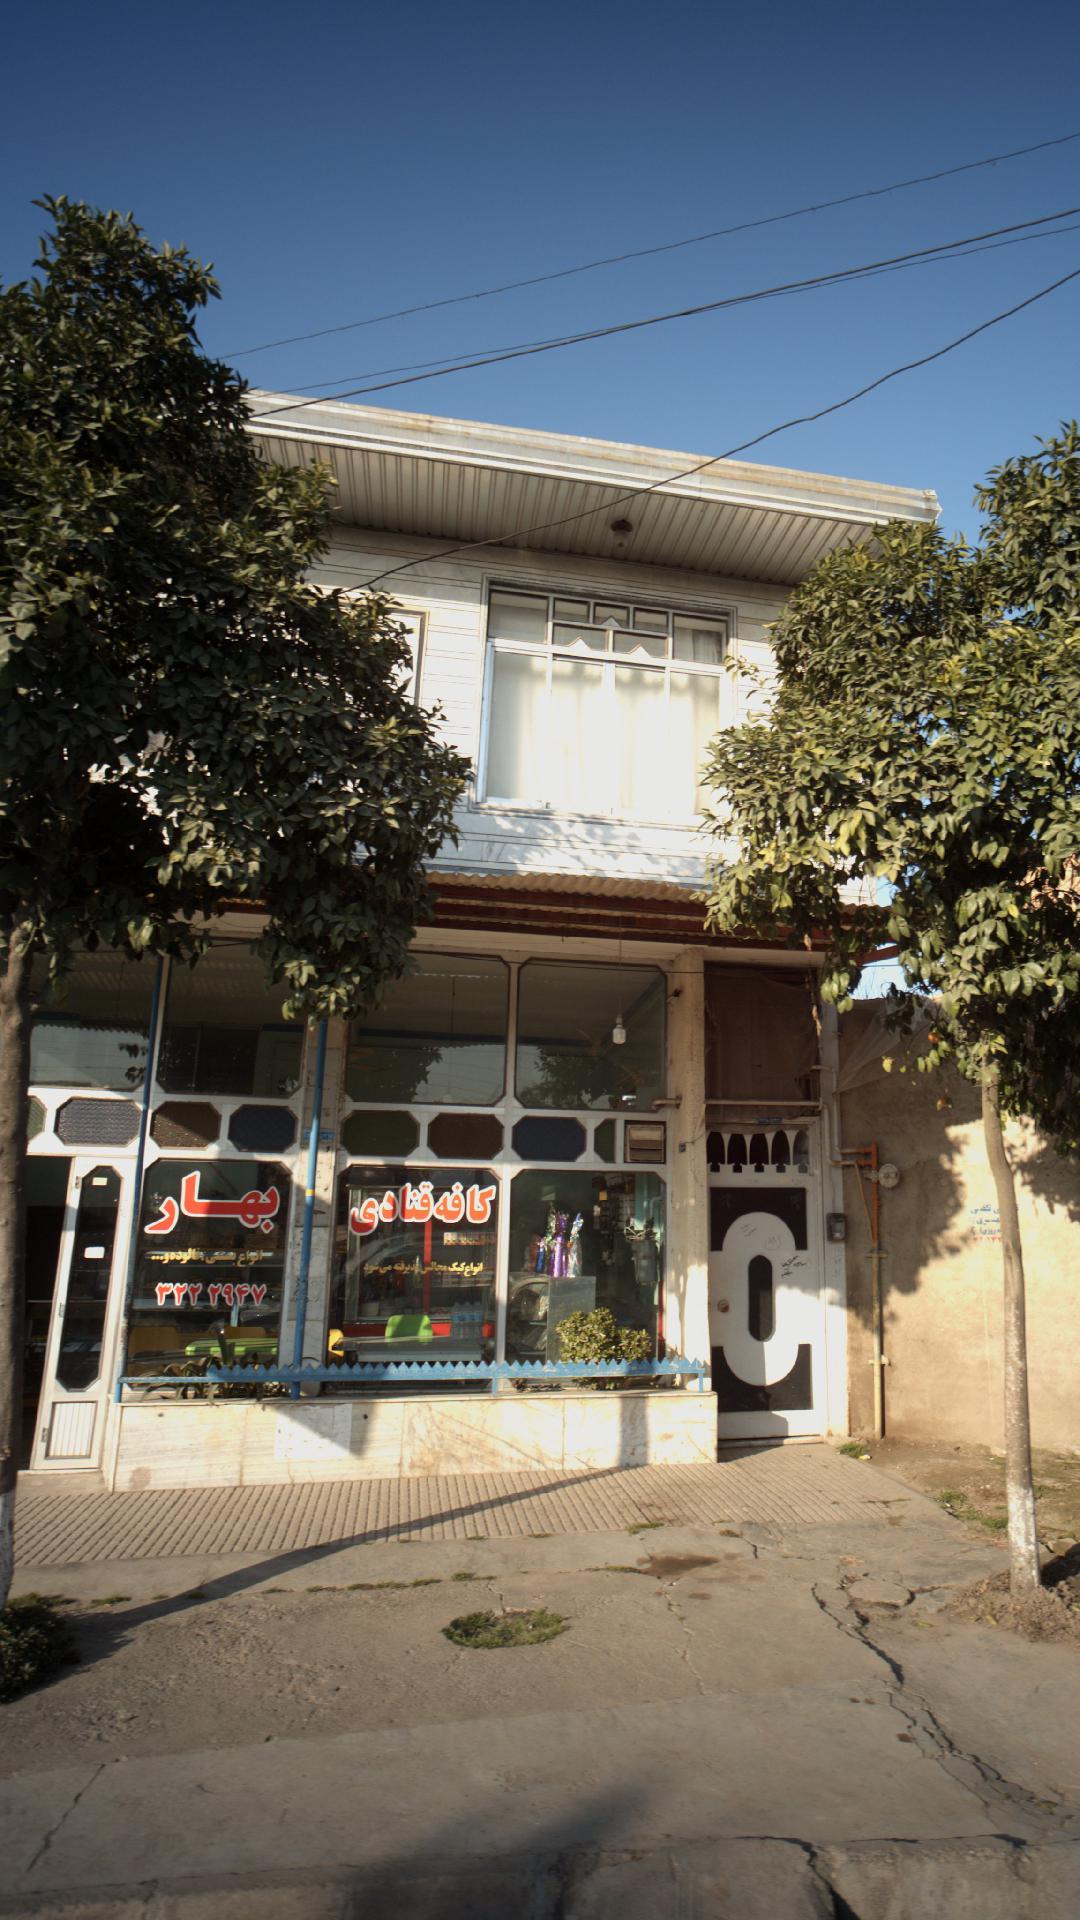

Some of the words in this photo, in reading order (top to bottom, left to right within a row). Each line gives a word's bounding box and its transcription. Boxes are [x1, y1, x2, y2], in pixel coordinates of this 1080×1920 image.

[144, 1170, 280, 1234] بهار
[350, 1181, 434, 1236] قنادی
[433, 1181, 497, 1224] کافه
[236, 1249, 264, 1267] انواع
[449, 1261, 466, 1275] کیک
[463, 1261, 484, 1277] انواع
[155, 1282, 203, 1306] ۳۲۲
[208, 1283, 267, 1306] ۲۹۴۷
